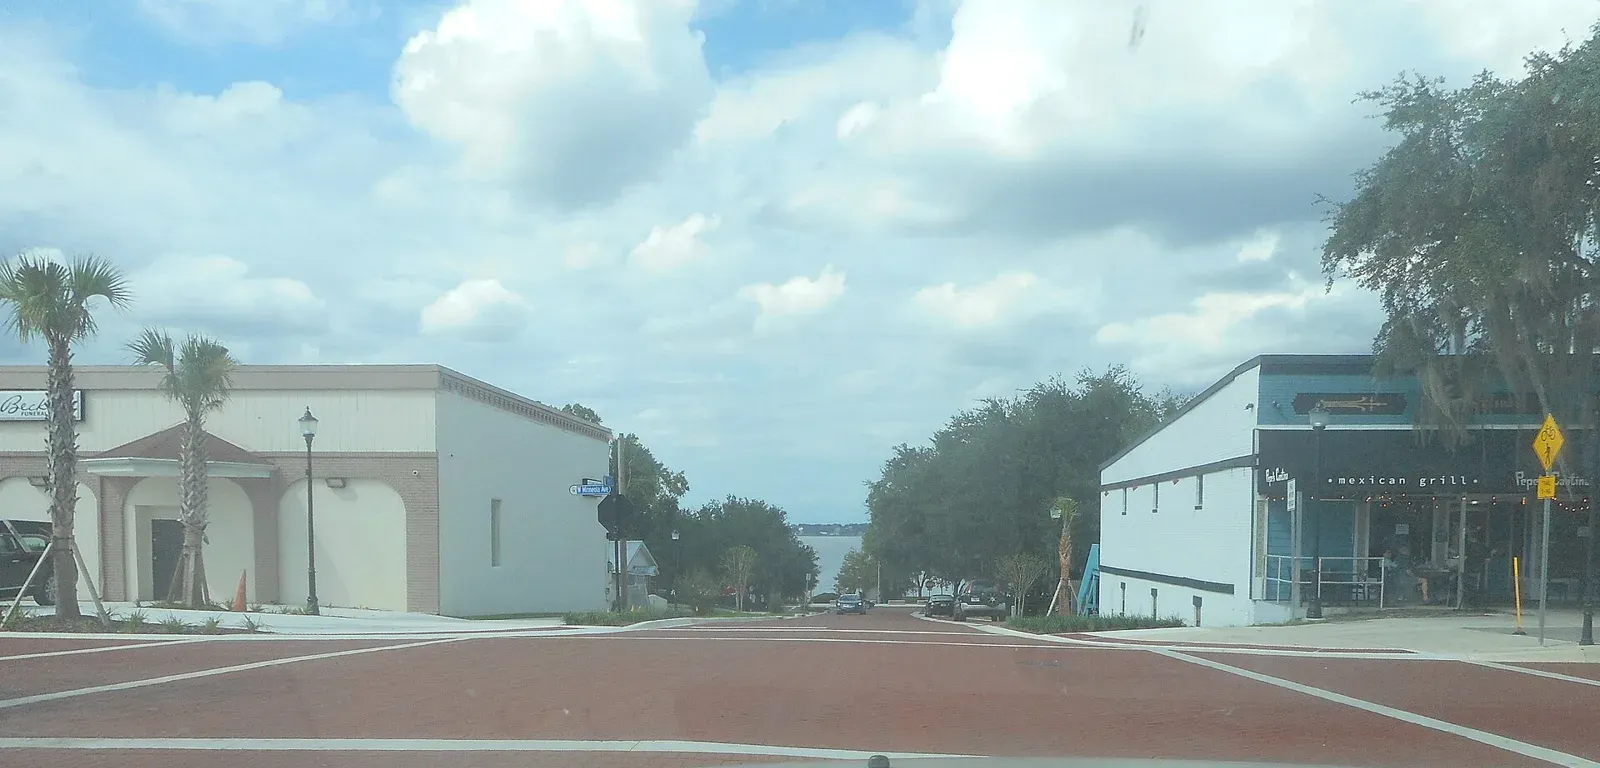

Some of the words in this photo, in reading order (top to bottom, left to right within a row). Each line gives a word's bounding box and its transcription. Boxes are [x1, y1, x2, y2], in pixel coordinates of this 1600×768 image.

[0, 395, 48, 414] Beck
[1338, 475, 1406, 485] mexican
[1419, 475, 1467, 487] grill
[1515, 471, 1539, 490] Pepe
[601, 485, 609, 493] Ave
